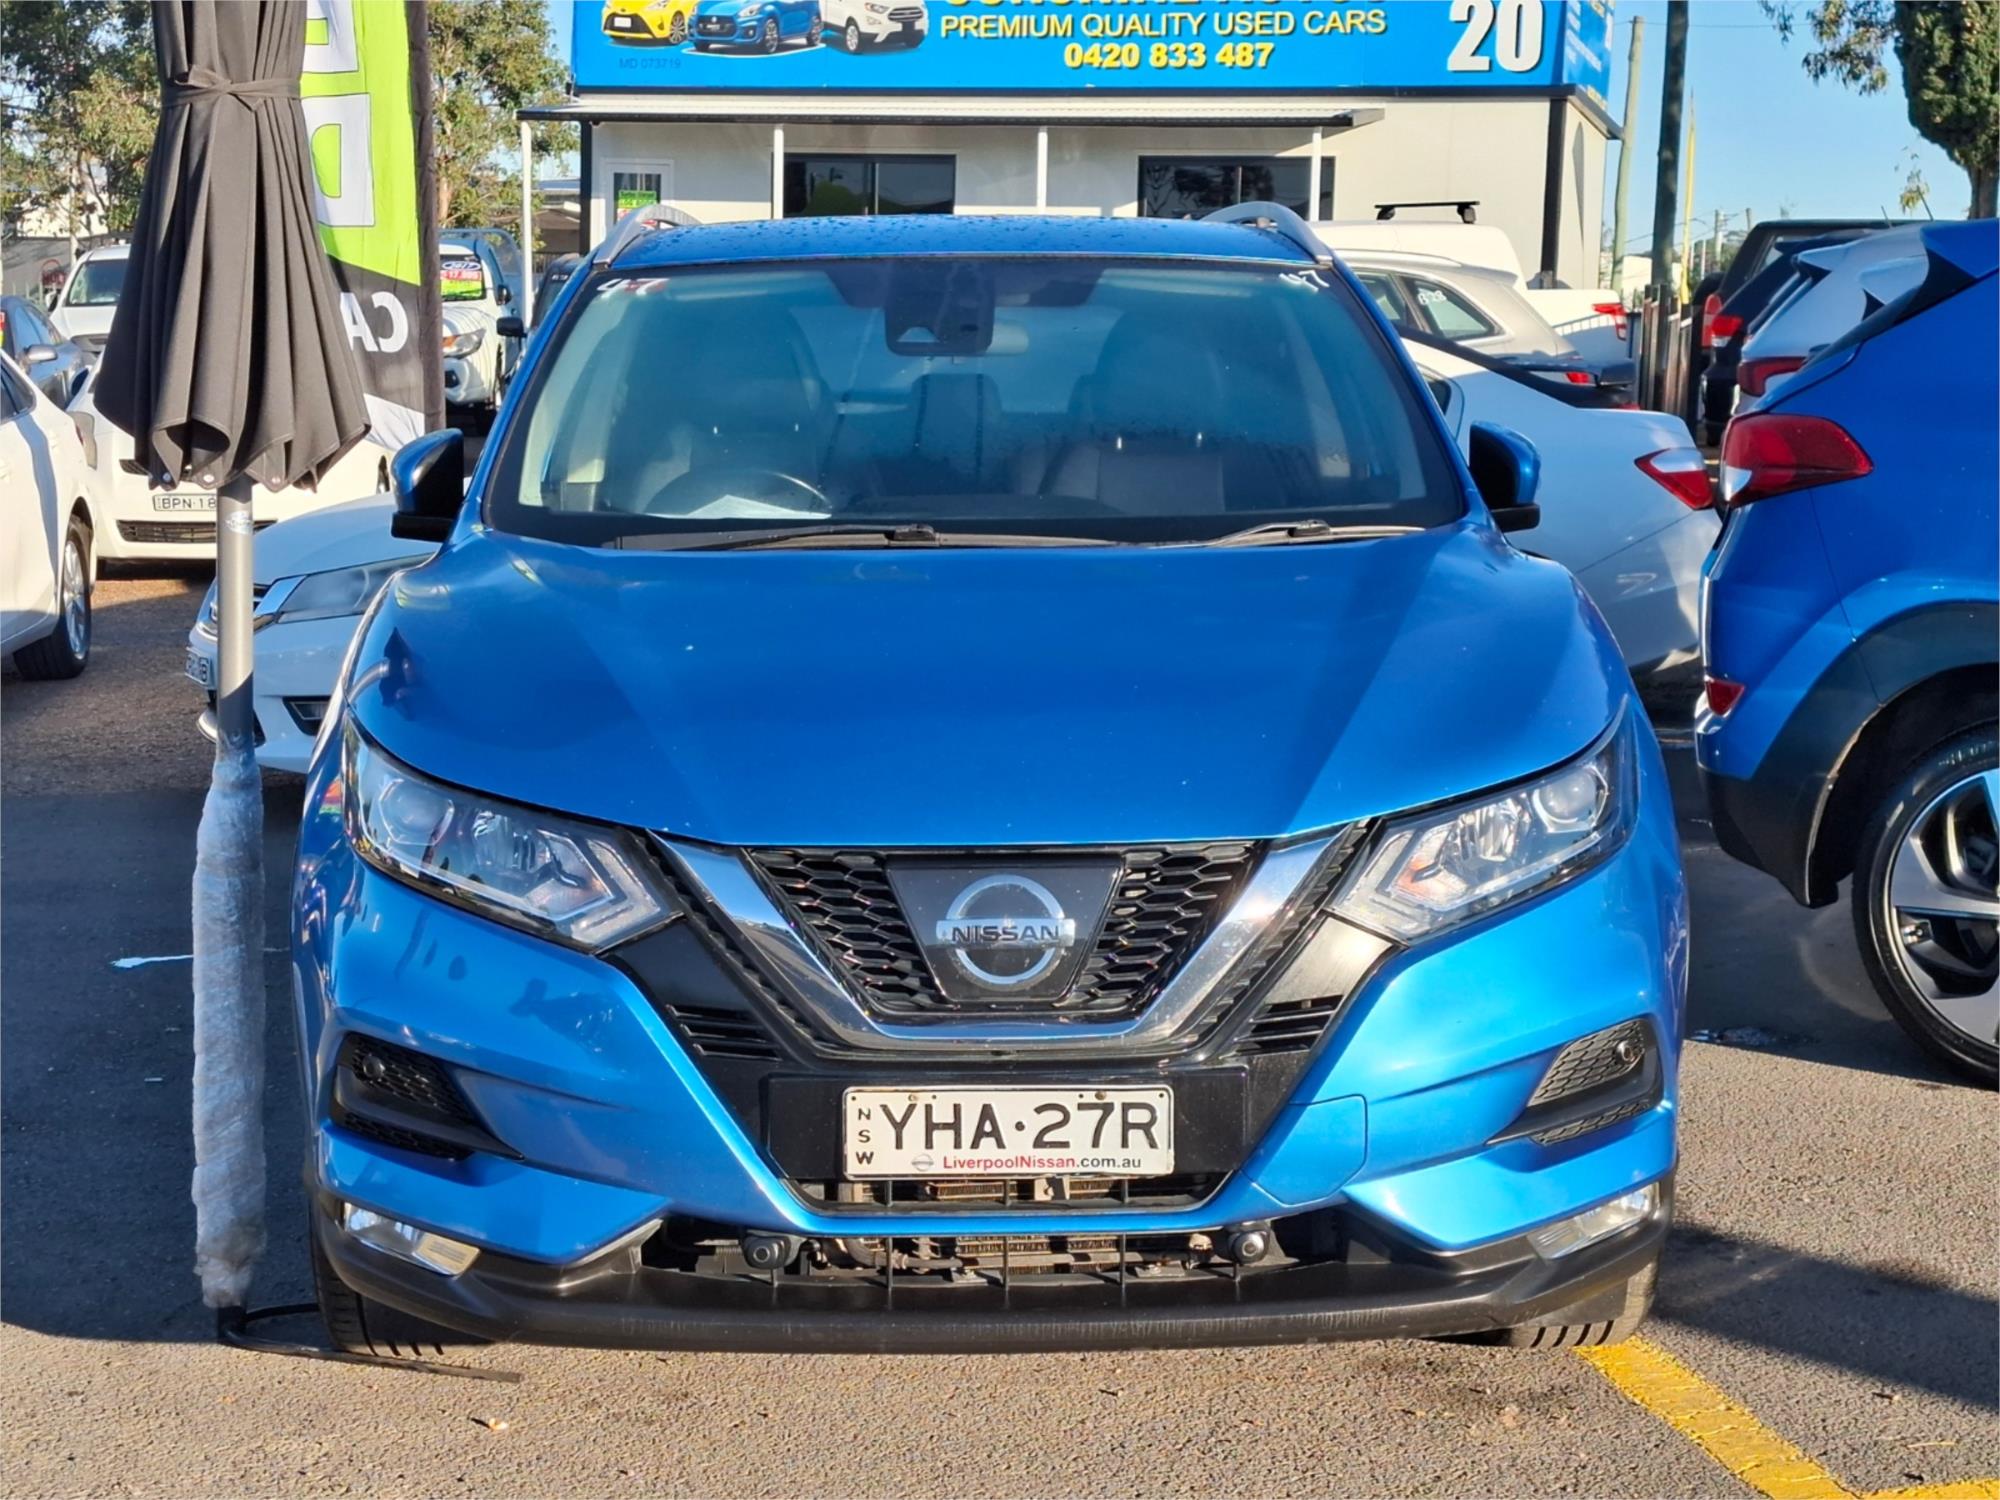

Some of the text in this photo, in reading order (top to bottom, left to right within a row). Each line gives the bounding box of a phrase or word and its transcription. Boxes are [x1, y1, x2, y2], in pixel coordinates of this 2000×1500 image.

[940, 9, 1388, 39] PREMIUM QUALITY USED CARS
[1447, 0, 1544, 73] 20
[619, 57, 637, 69] MD
[1063, 42, 1275, 69] 0420 833 487
[952, 925, 1059, 943] NISSAN
[943, 1155, 1142, 1171] LiverpoolNissan.com.au
